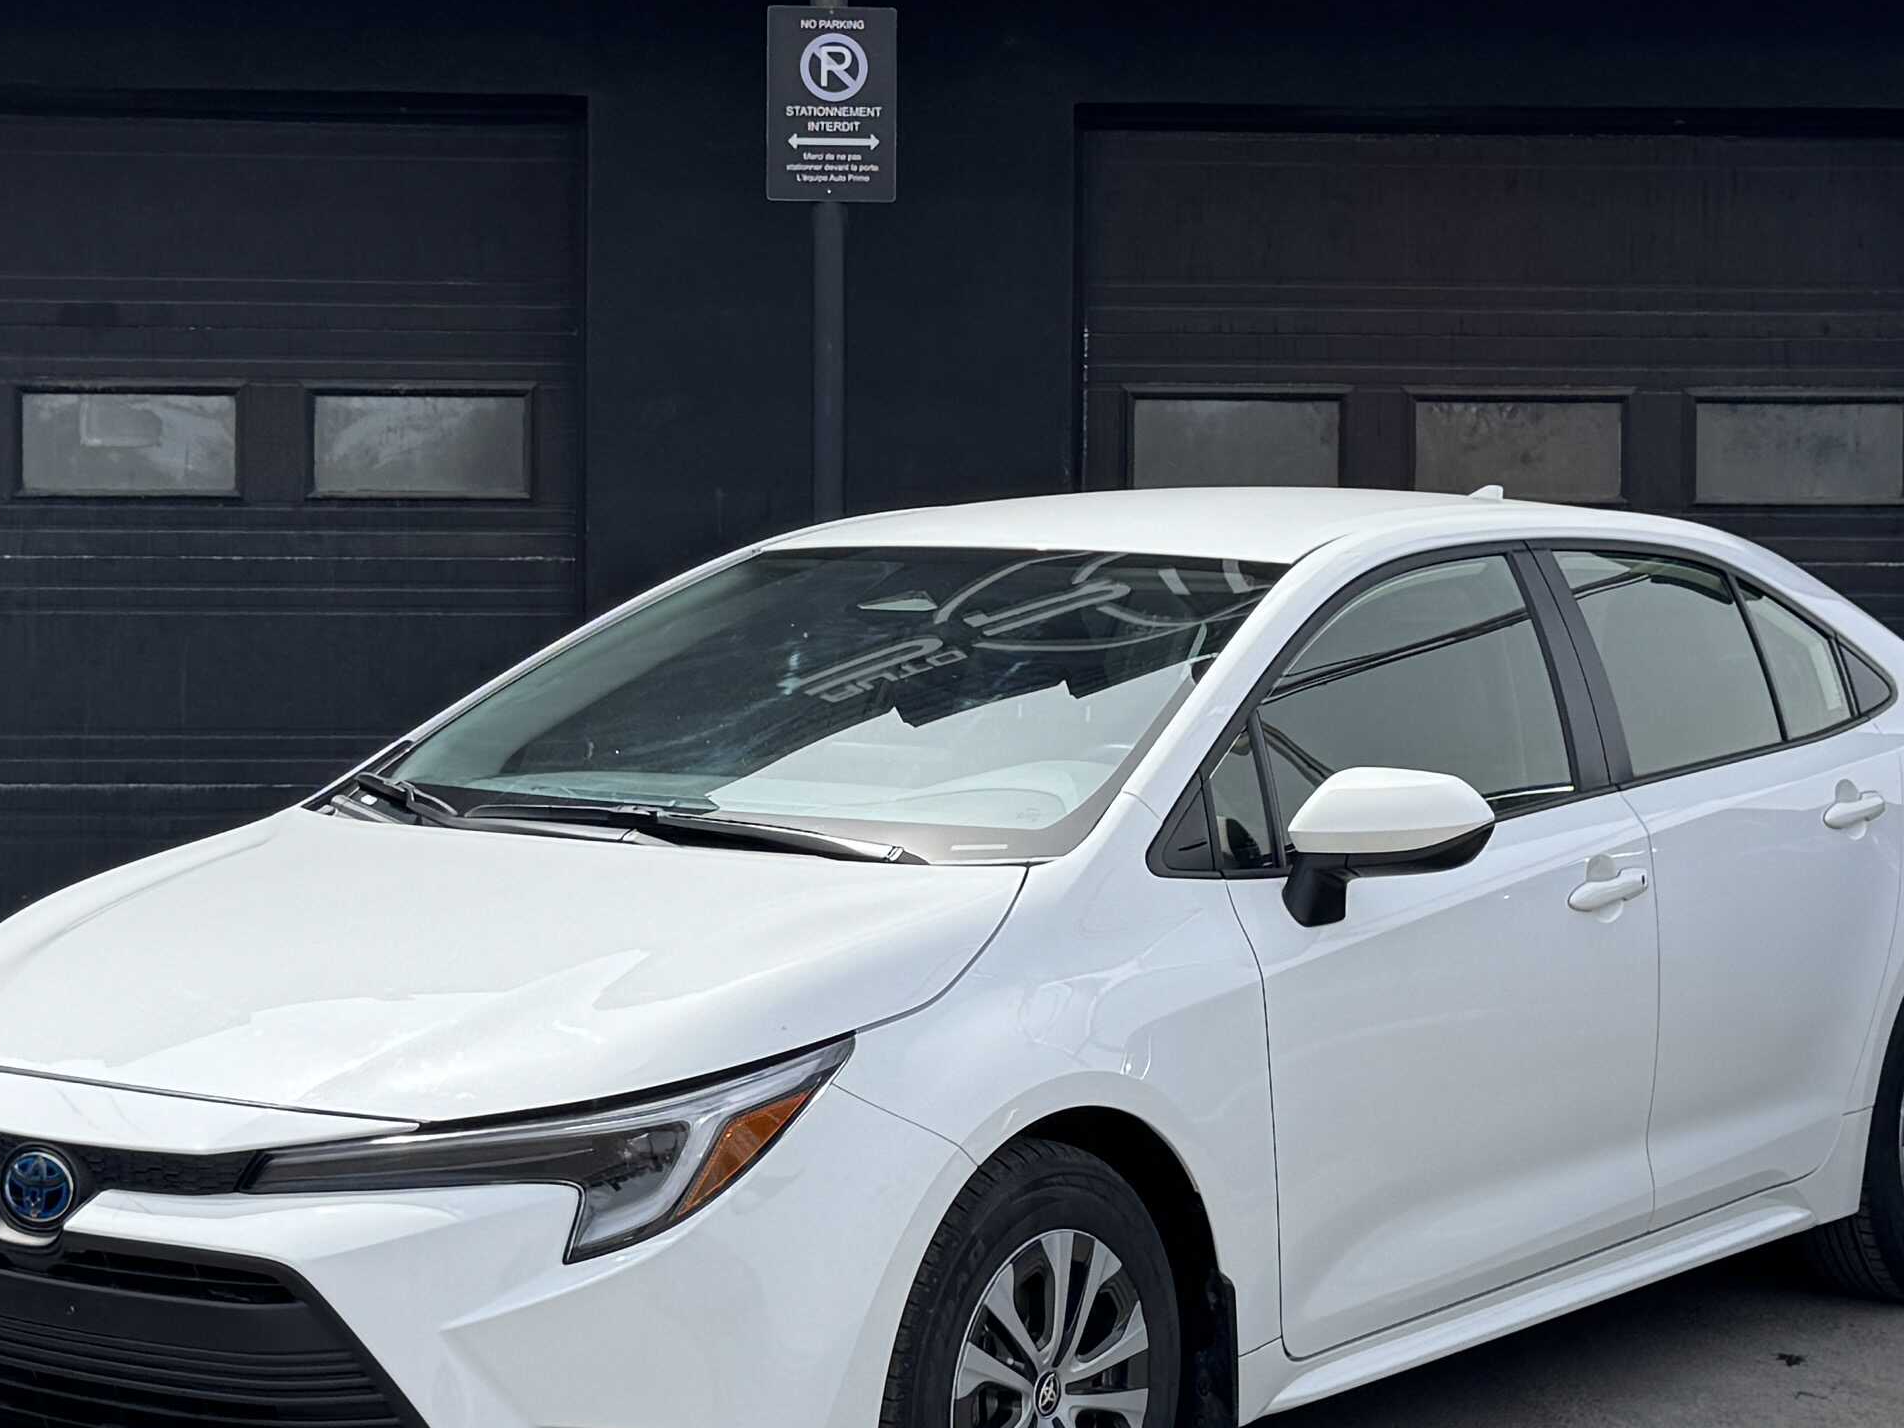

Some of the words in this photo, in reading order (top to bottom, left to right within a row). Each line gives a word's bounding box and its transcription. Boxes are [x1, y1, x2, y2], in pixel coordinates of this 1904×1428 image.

[800, 19, 816, 29] NO
[818, 19, 865, 30] PARKING
[785, 105, 882, 117] STATIONNEMENT
[807, 121, 861, 132] INTERDIT
